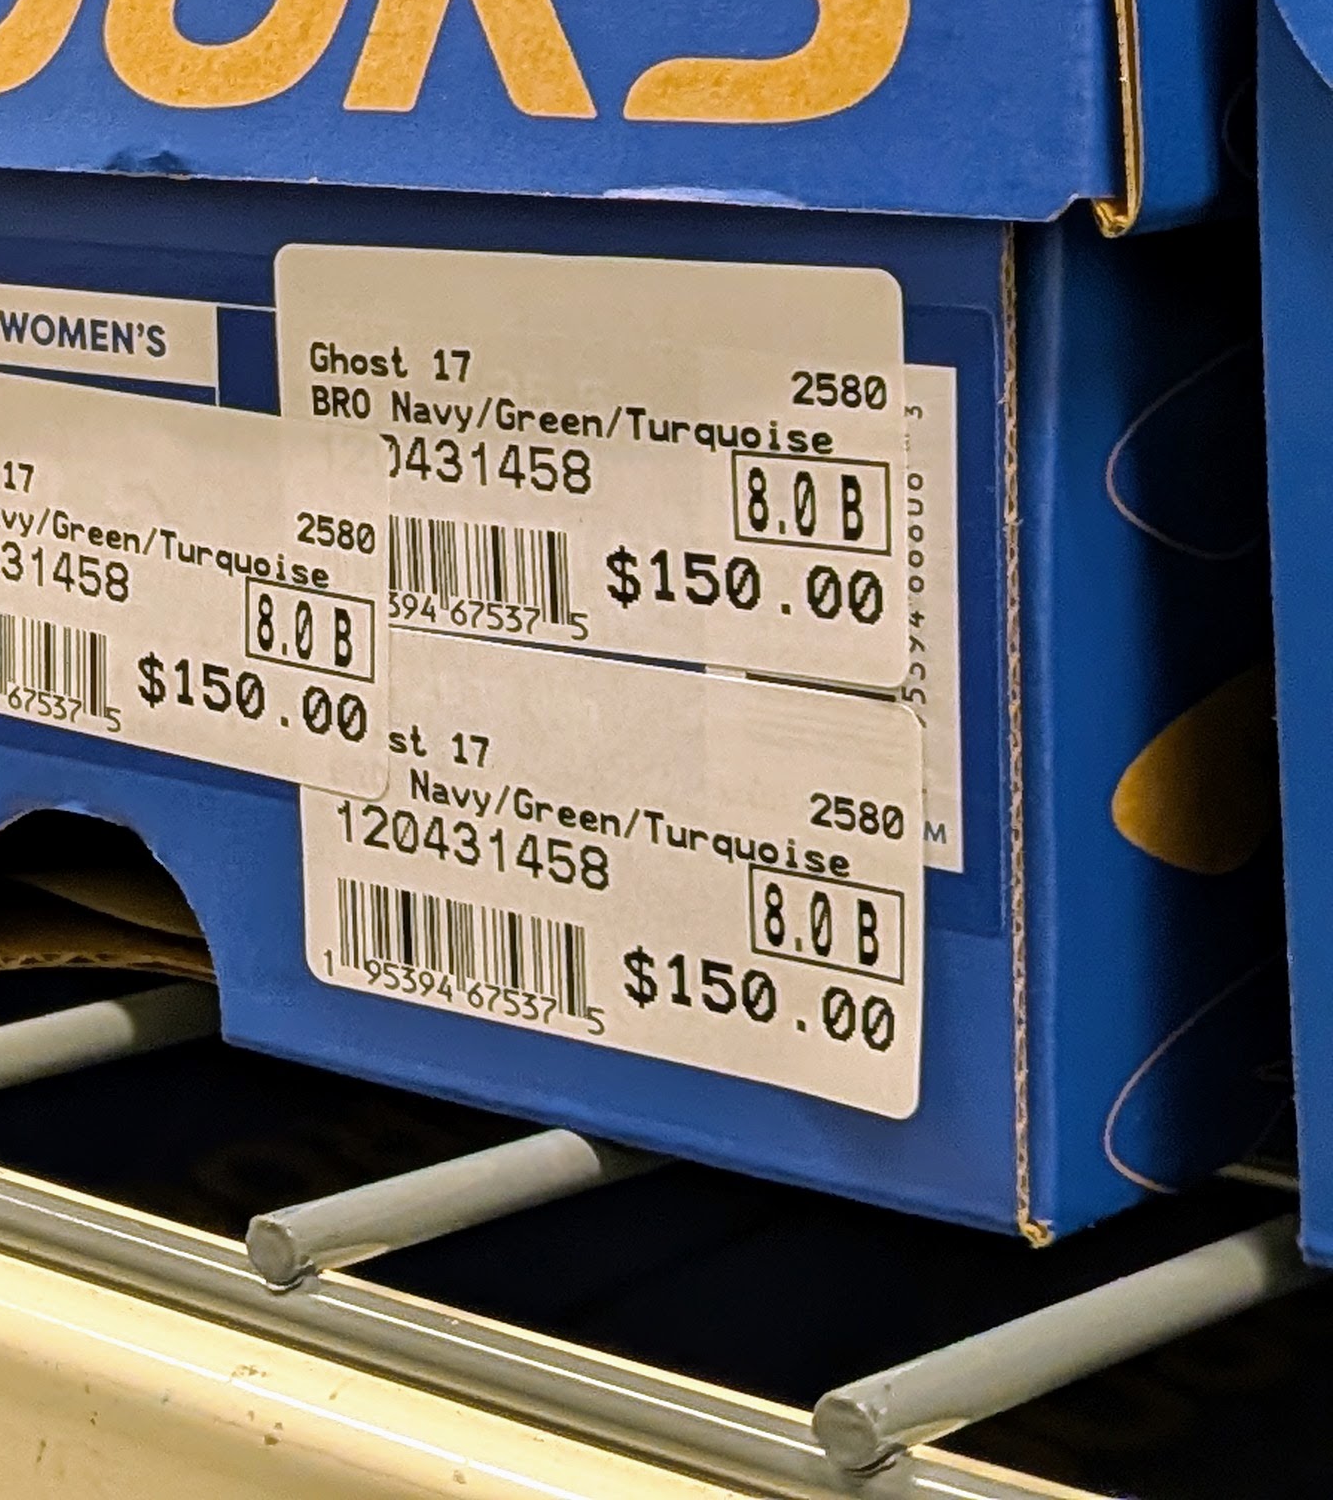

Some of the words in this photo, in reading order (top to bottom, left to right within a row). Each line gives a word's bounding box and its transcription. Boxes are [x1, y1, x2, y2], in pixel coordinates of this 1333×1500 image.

[309, 341, 409, 380] Ghost
[433, 350, 471, 383] 17
[790, 370, 888, 411] 2580
[311, 385, 371, 420] BRO
[392, 391, 833, 454] Navy/Green/Turquoise
[3, 460, 35, 494] 17
[380, 433, 592, 495] 431458
[296, 511, 376, 555] 2580
[747, 467, 816, 537] 8.0
[841, 473, 863, 541] B
[606, 544, 883, 625] $150.00
[256, 593, 313, 661] 8.0
[333, 606, 353, 668] B
[450, 599, 541, 635] 67537
[571, 612, 589, 641] 5
[7, 685, 83, 724] 67537
[107, 707, 122, 733] 5
[137, 651, 367, 743] $150.00
[451, 732, 489, 768] 17
[337, 801, 609, 891] 120431458
[410, 769, 851, 877] Navy/Green/Turquoise
[810, 792, 904, 840] 2580
[763, 882, 832, 956] 8.0
[857, 898, 879, 966] B
[364, 959, 453, 1003] 95394
[466, 981, 557, 1025] 67537
[587, 1005, 606, 1036] 5
[623, 944, 894, 1051] $150.00
